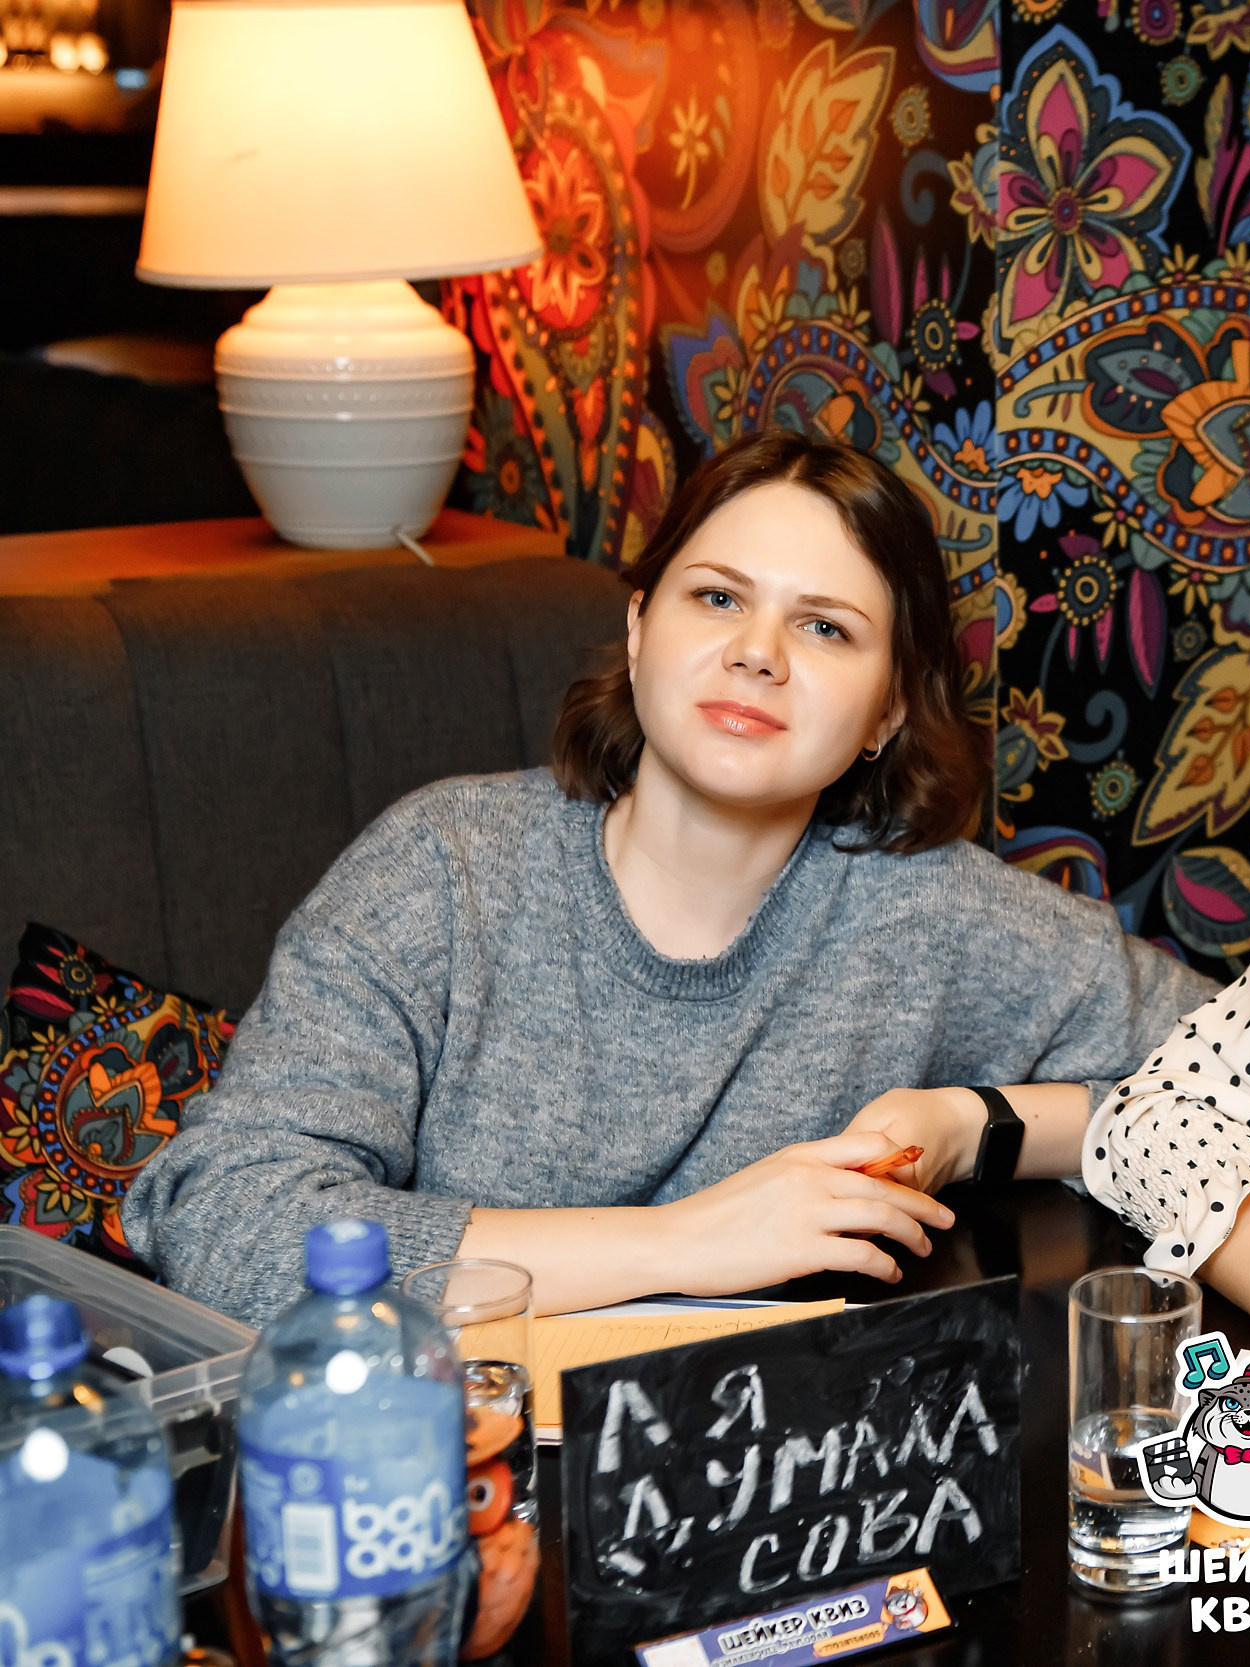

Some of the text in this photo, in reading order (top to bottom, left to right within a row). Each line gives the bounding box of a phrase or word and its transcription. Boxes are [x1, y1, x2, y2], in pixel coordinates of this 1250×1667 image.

[705, 1363, 768, 1440] Я
[738, 1475, 984, 1594] СОВА
[719, 1598, 867, 1651] ШЕЙКЕР КВИЗ
